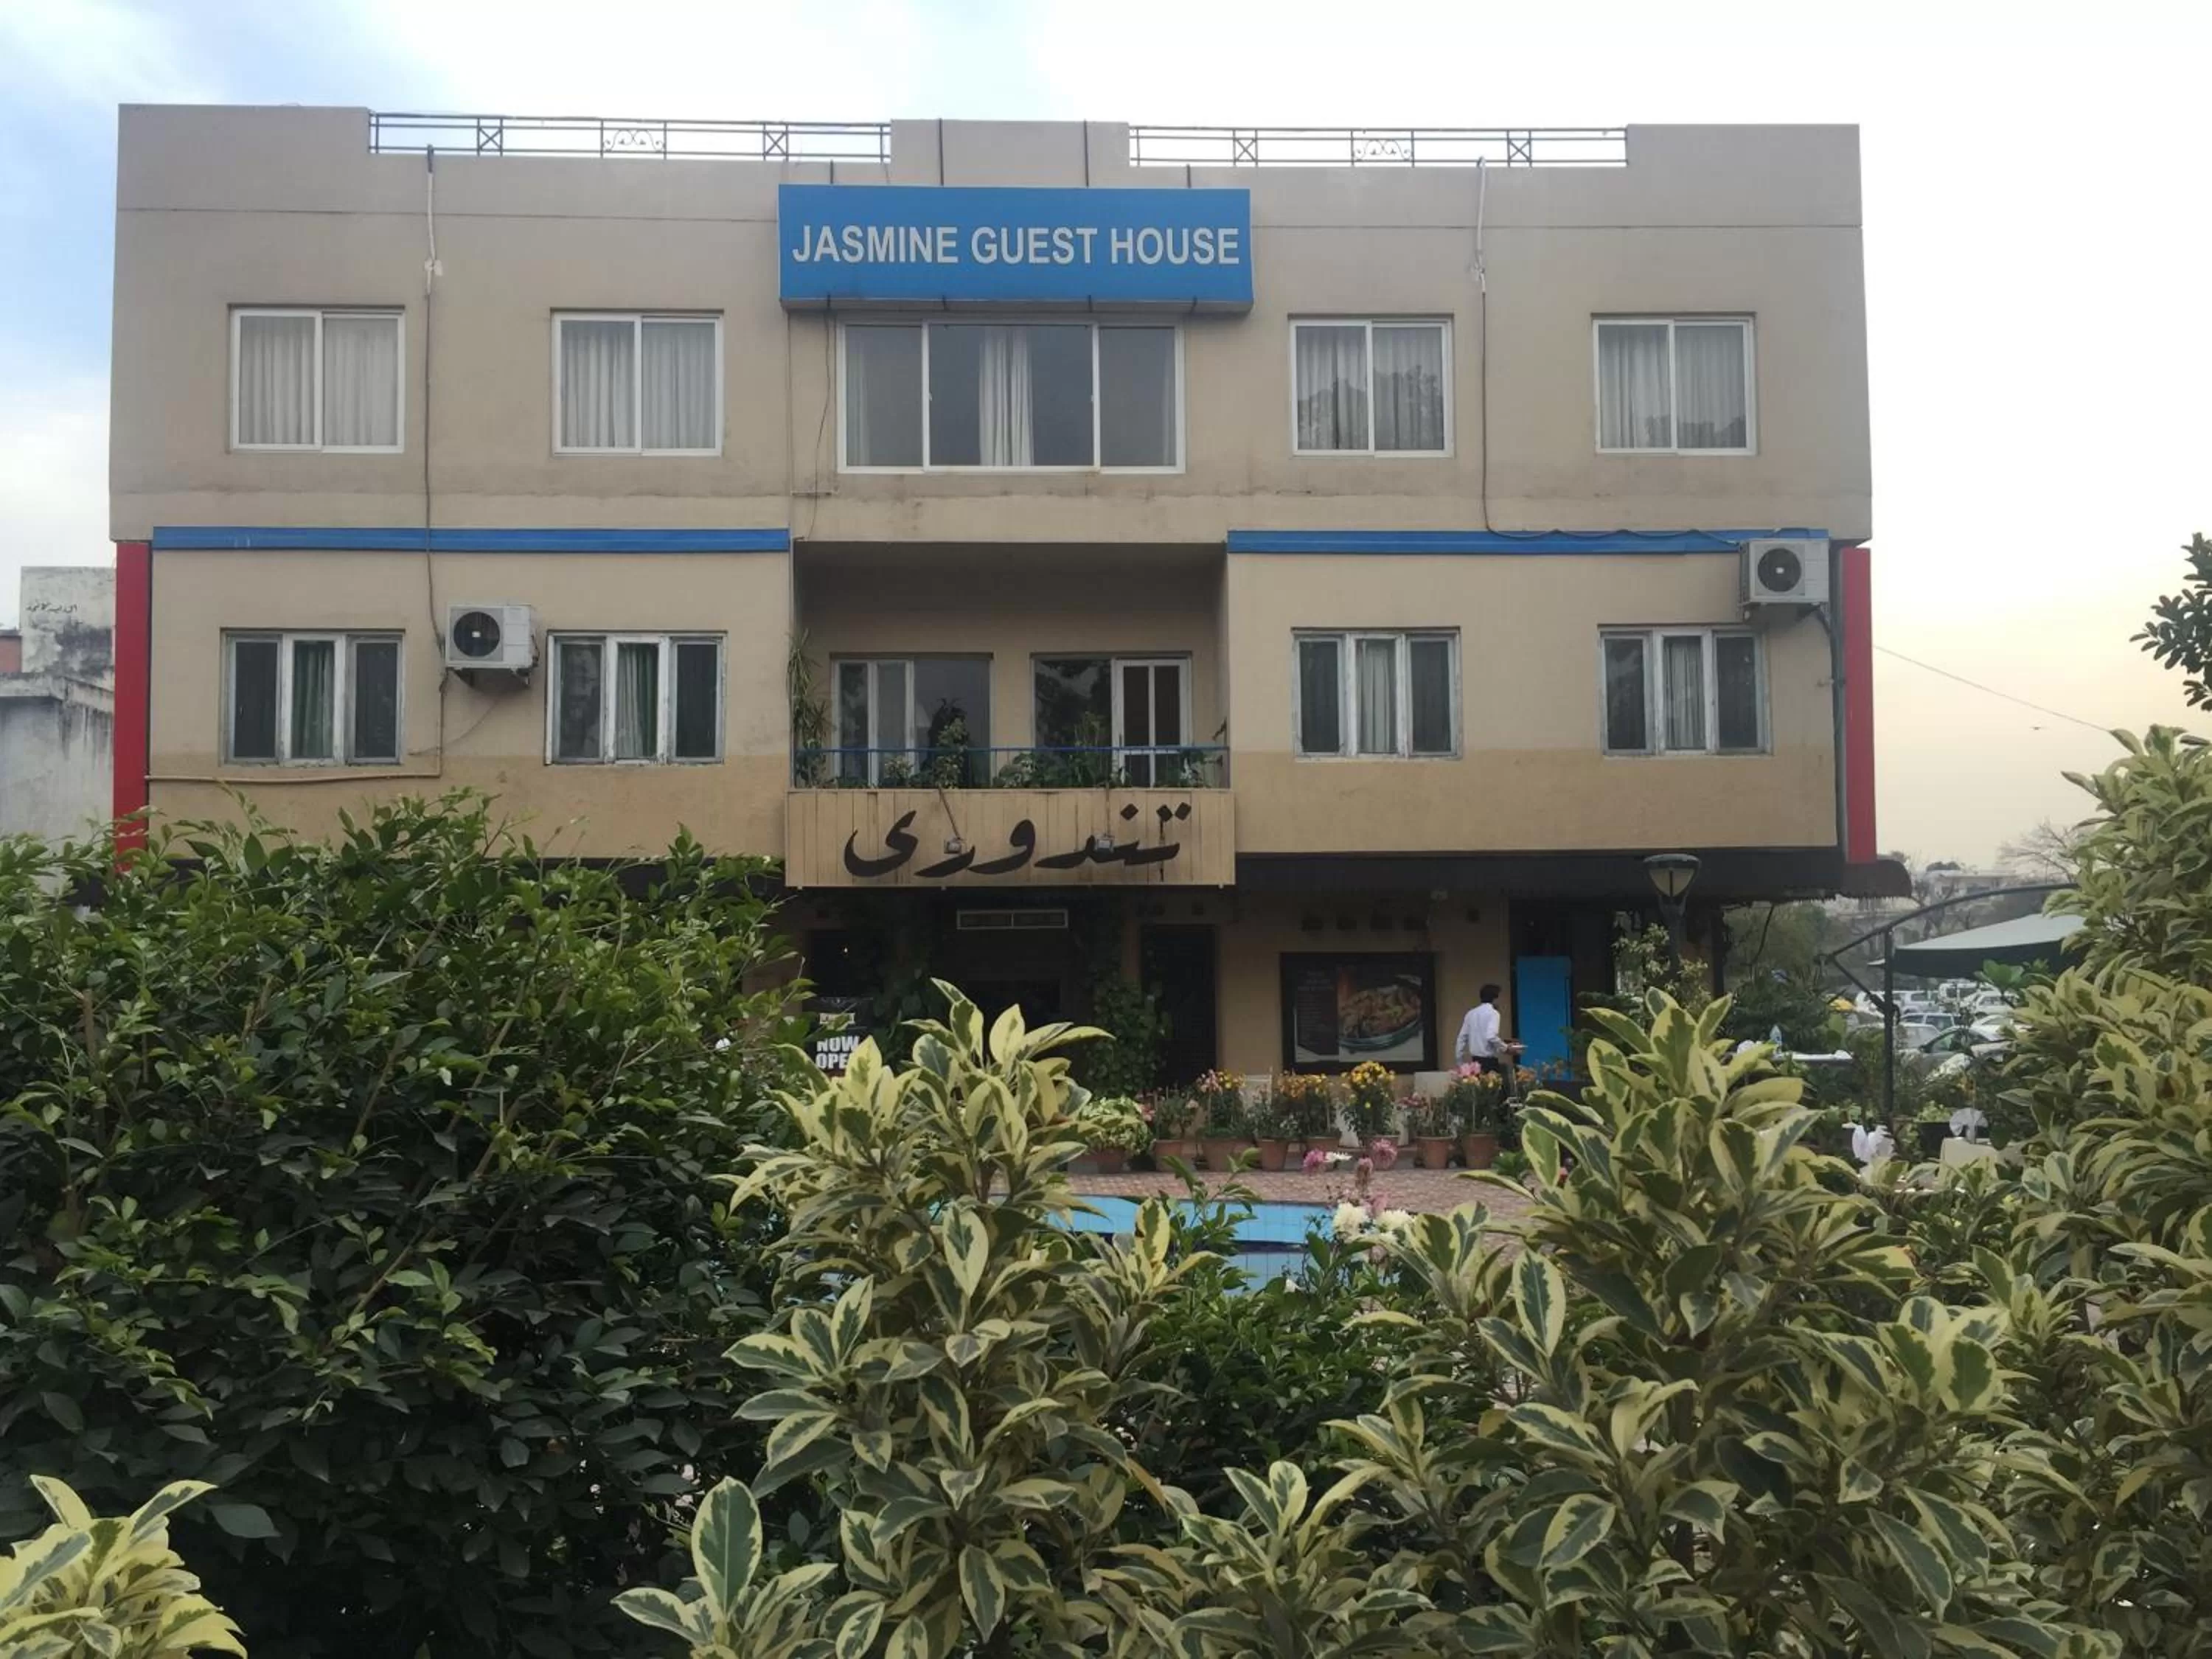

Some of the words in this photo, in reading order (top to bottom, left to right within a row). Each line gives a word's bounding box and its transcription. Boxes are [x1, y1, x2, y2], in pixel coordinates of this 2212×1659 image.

[792, 225, 959, 264] JASMINE
[970, 226, 1098, 265] GUEST
[1110, 227, 1240, 265] HOUSE
[816, 1035, 860, 1052] NOW
[815, 1053, 848, 1069] OPE
